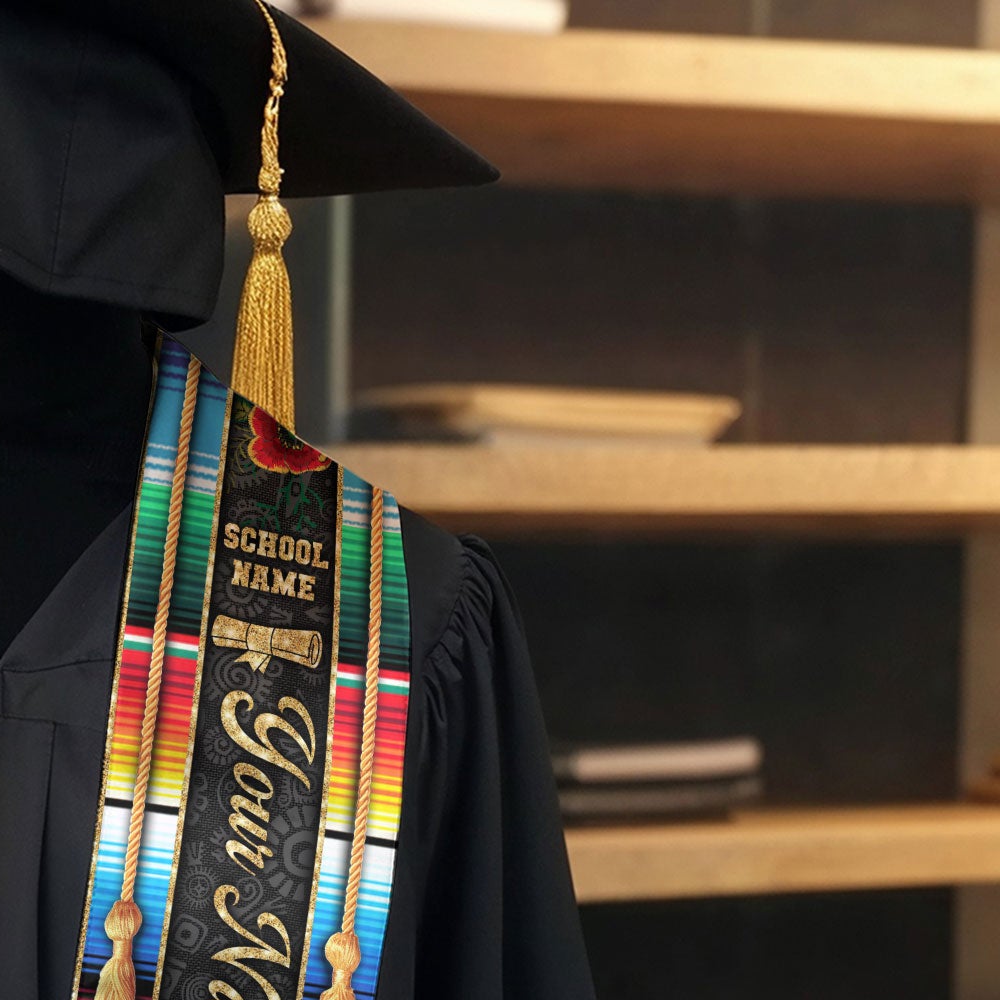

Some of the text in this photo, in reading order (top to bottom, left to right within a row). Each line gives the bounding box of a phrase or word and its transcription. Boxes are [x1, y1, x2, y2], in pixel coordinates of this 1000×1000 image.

[223, 522, 329, 570] SCHOOL
[231, 559, 316, 602] NAME
[220, 690, 316, 876] Your
